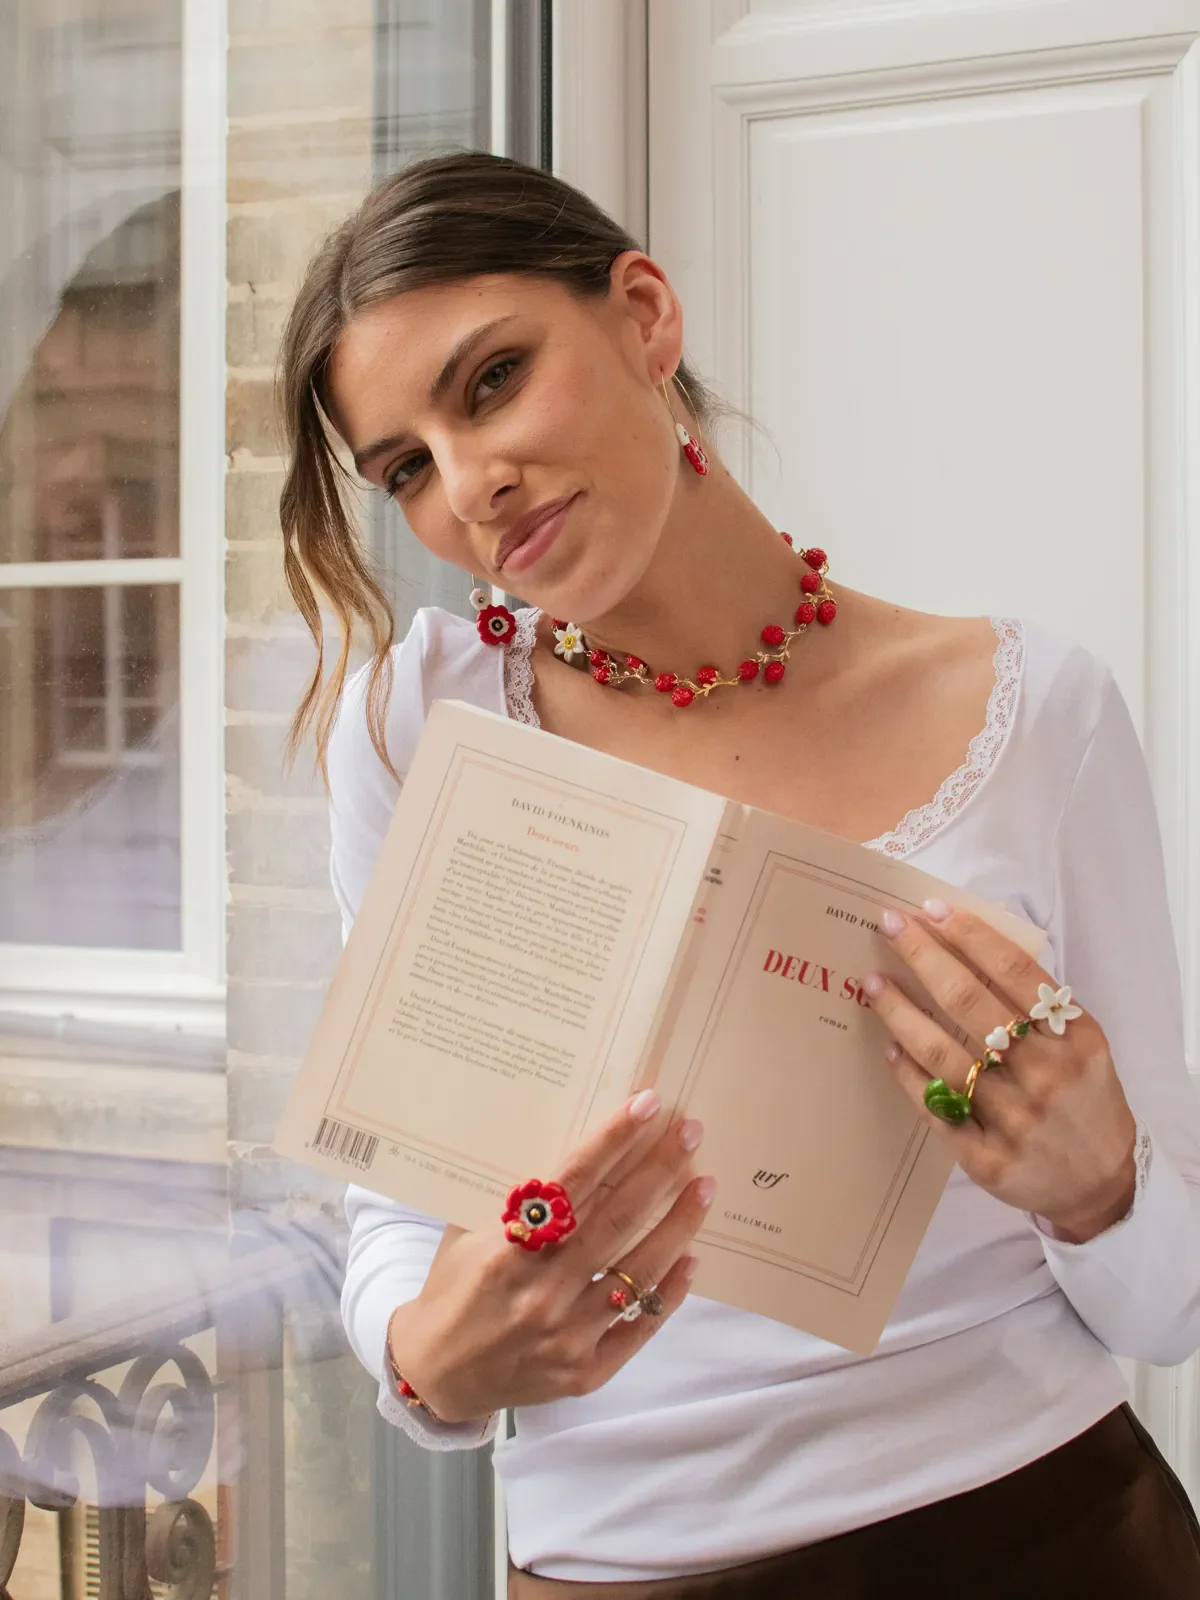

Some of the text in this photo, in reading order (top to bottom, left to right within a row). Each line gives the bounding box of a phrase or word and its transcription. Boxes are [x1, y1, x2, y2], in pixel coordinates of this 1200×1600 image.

[511, 797, 545, 816] DAVID
[826, 905, 881, 934] DAVID FOE
[762, 949, 836, 993] DEUX
[818, 1014, 849, 1031] roman
[752, 1169, 790, 1190] nrf
[724, 1211, 783, 1235] GALLIMARD
